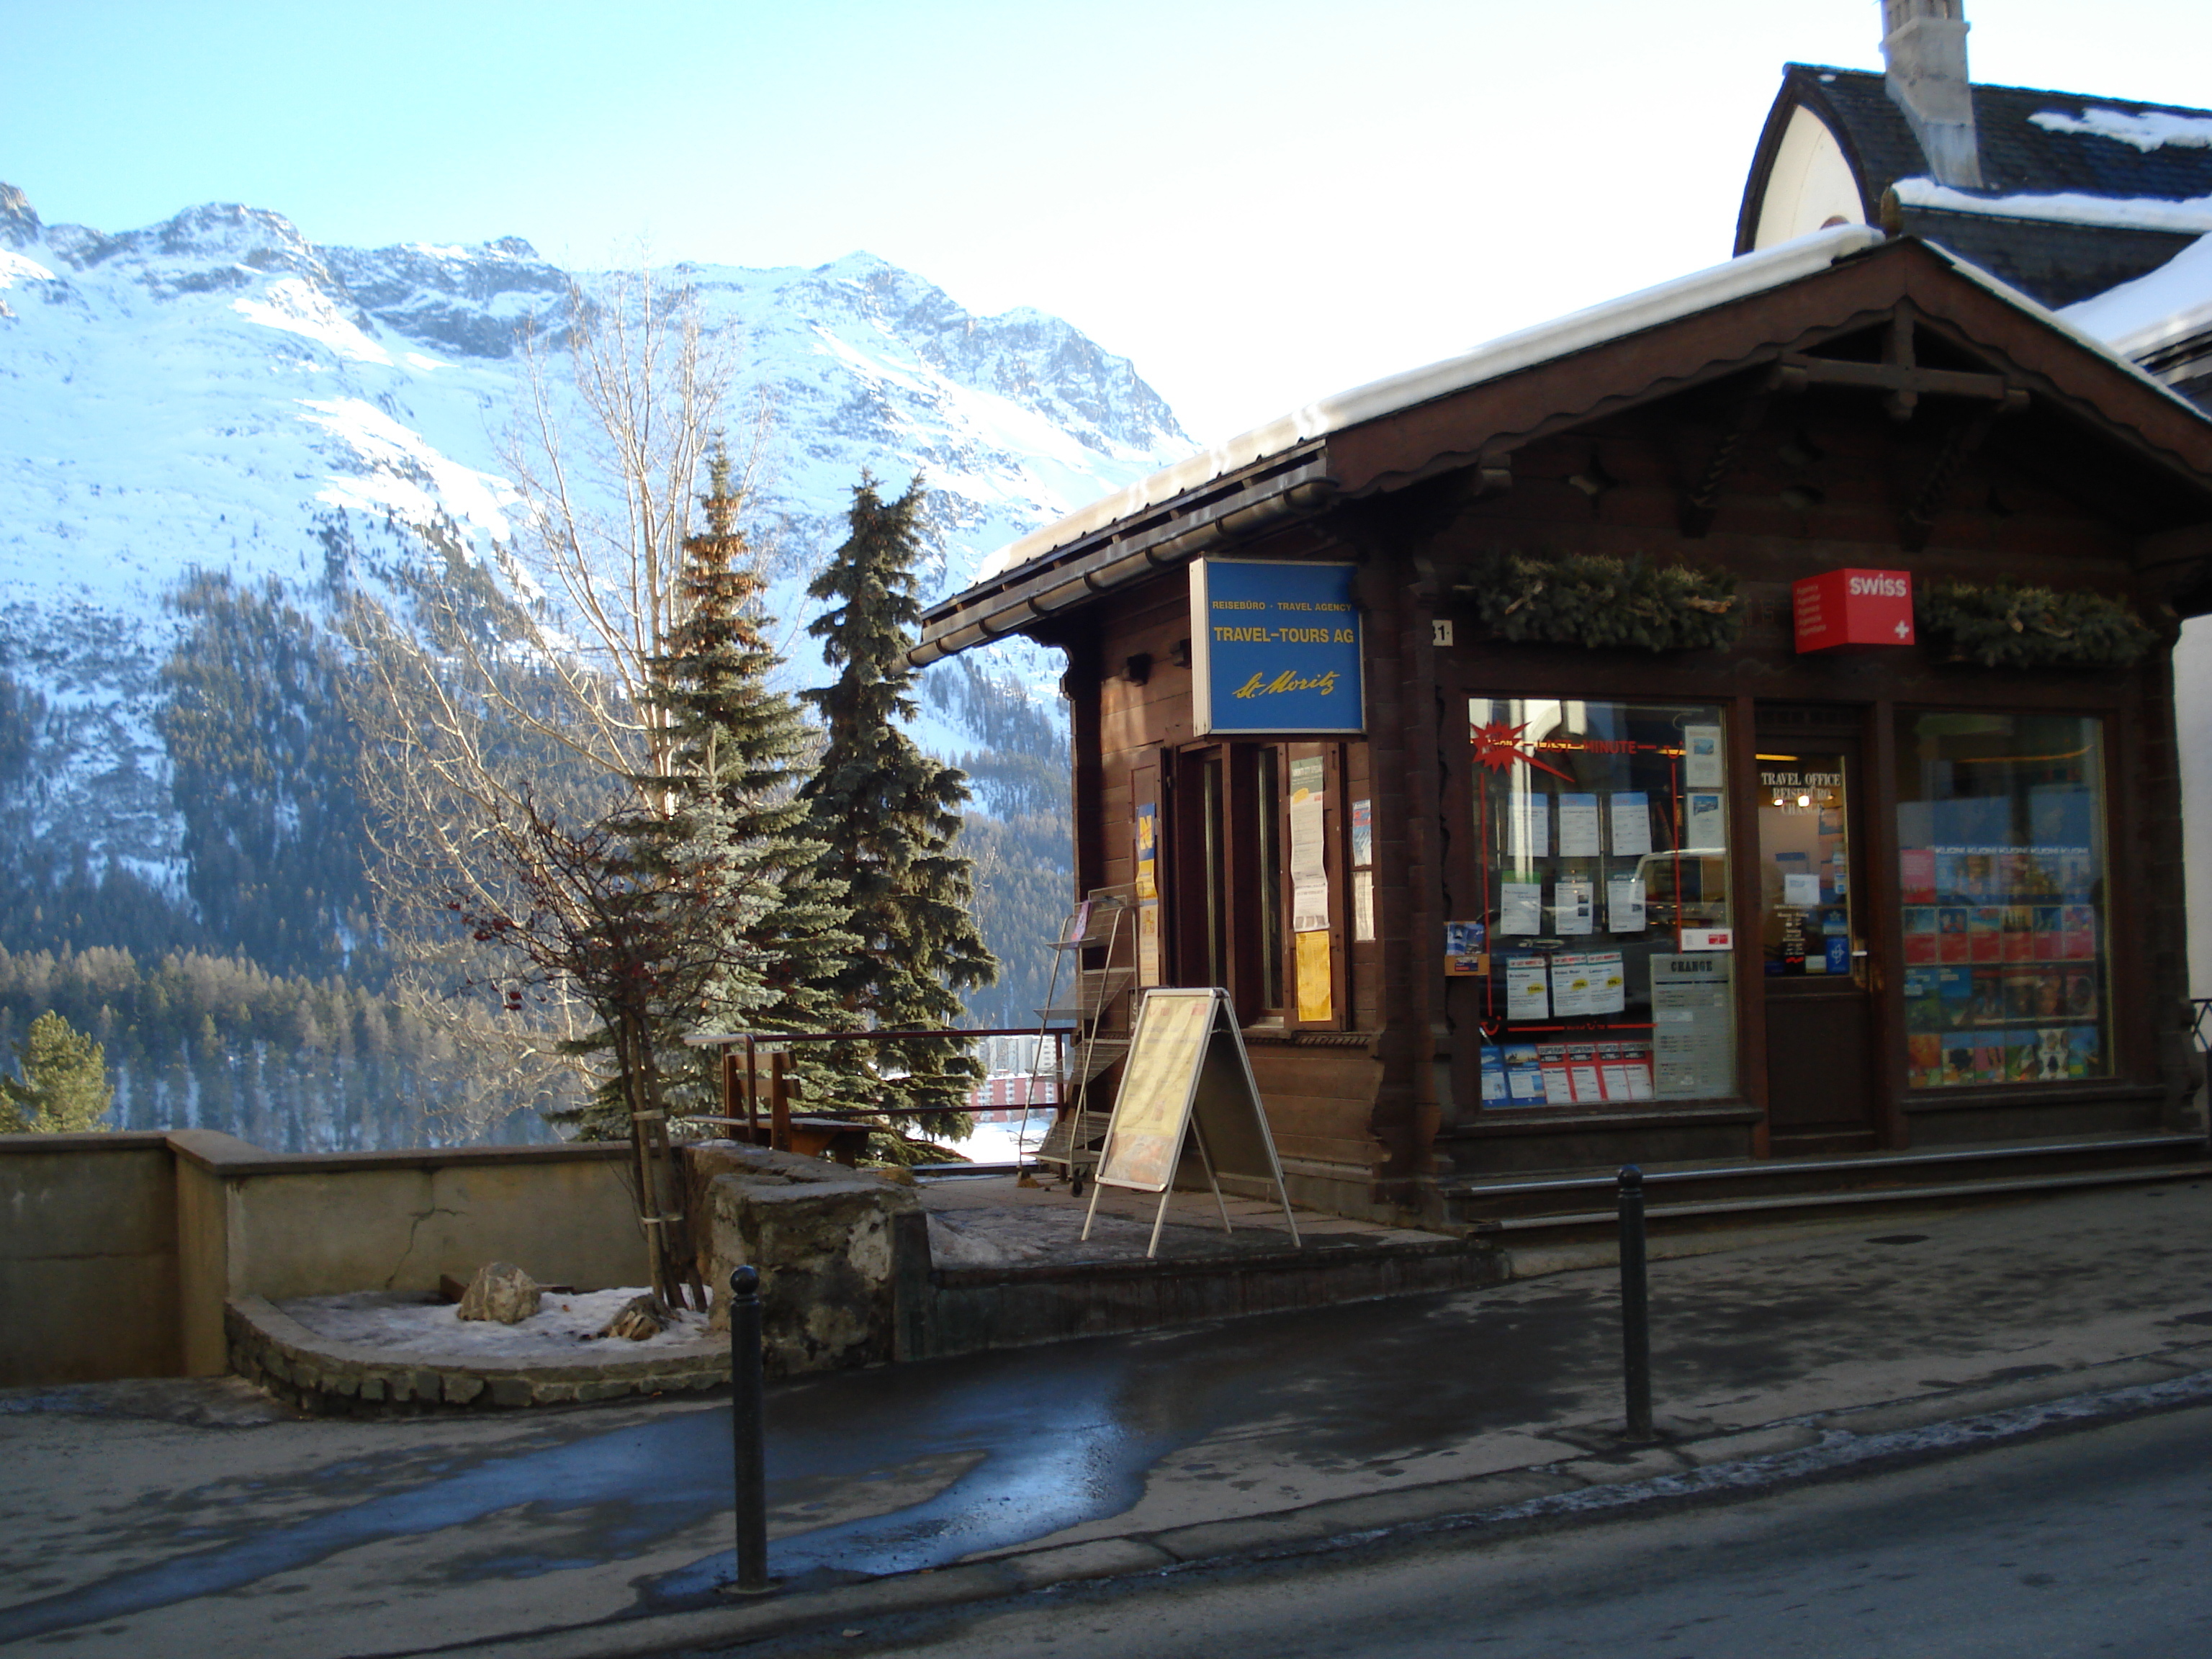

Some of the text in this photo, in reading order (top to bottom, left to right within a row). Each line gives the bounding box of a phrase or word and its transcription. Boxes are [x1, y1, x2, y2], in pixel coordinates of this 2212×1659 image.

[1849, 574, 1907, 597] swiss
[1213, 601, 1266, 610] REISEBÜRO
[1315, 603, 1352, 611] AGENCY
[1214, 627, 1354, 643] TRAVEL-TOURS AG
[1233, 670, 1341, 698] St. Moritz
[1583, 741, 1637, 754] MINUTE
[1761, 772, 1840, 786] TRAVEL OFFICE
[1671, 961, 1712, 972] CHANGE
